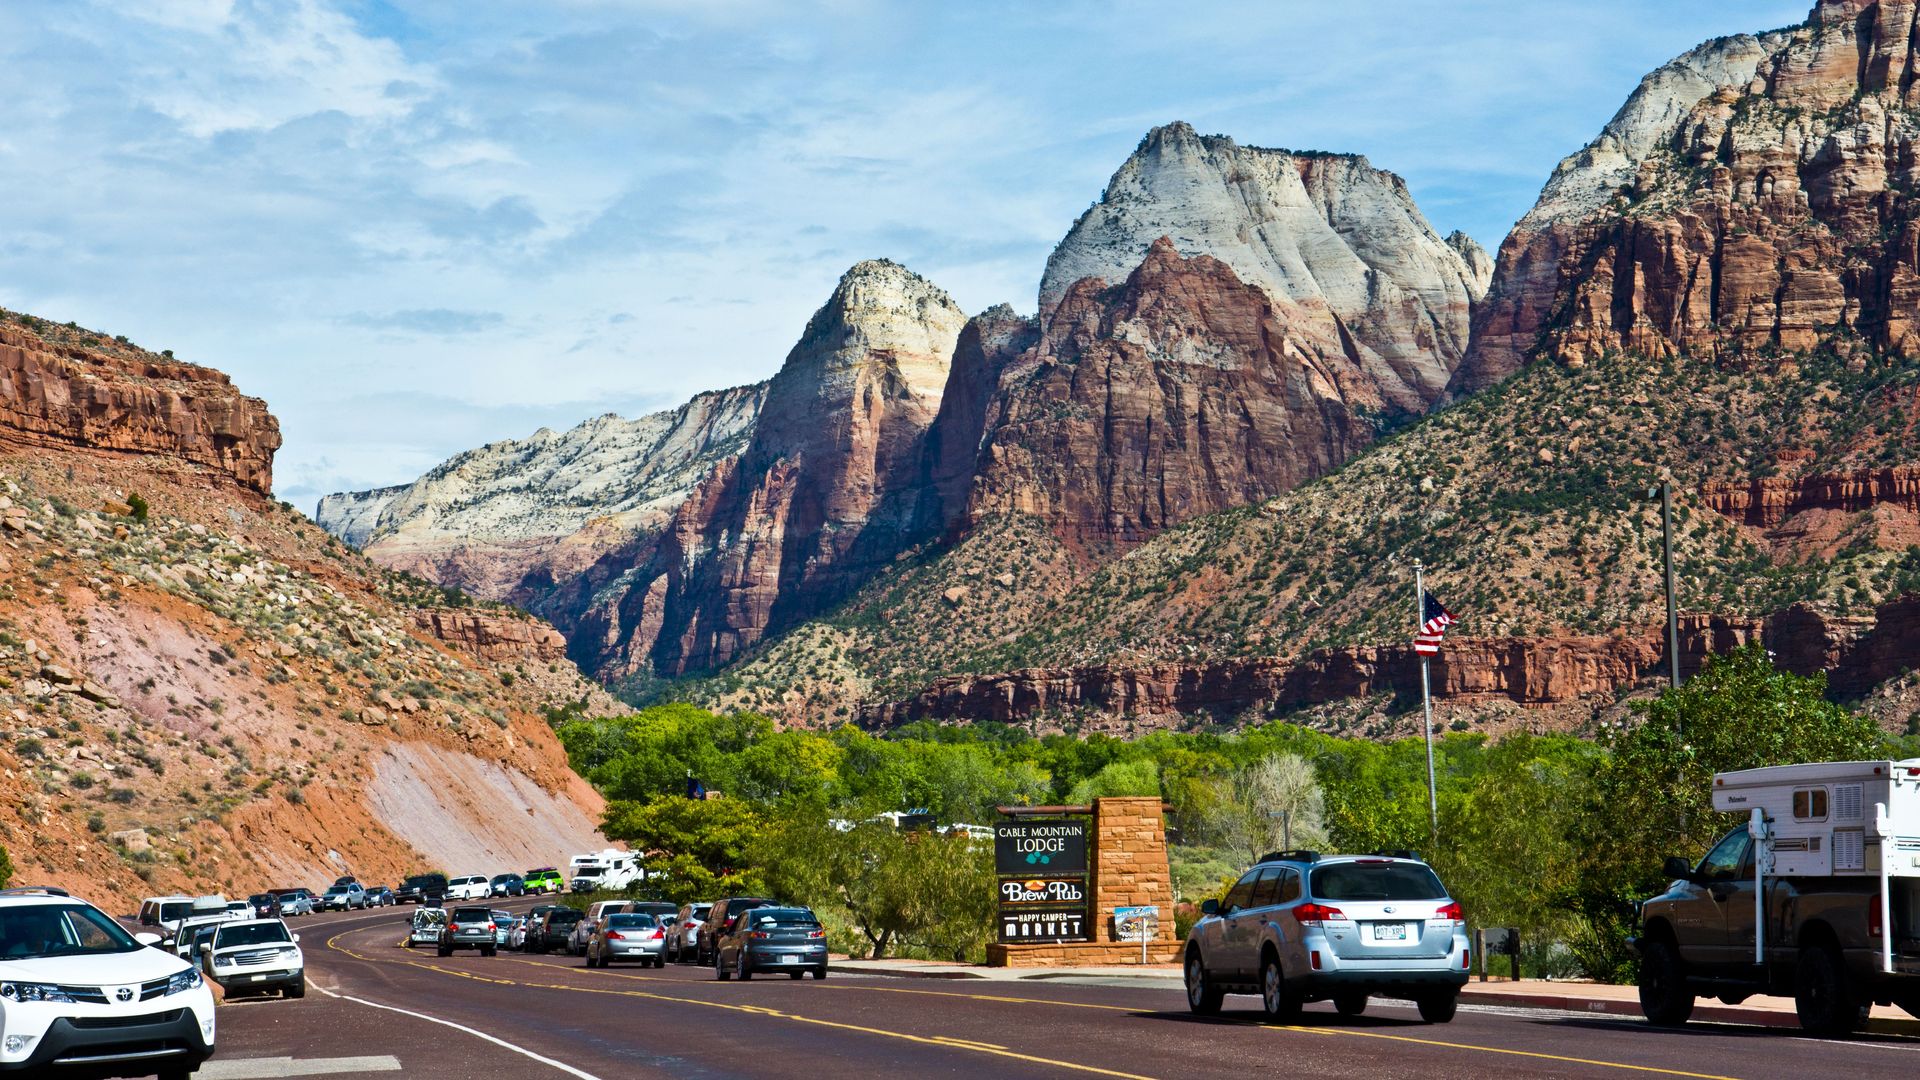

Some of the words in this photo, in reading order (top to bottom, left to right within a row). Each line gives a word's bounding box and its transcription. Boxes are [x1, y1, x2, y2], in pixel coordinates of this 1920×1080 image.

[999, 828, 1026, 837] CABLE
[1031, 827, 1082, 837] MOUNTAIN
[1017, 838, 1065, 852] LODGE
[1002, 882, 1048, 901] Brew
[1048, 882, 1082, 900] Pub
[1019, 914, 1040, 922] HAPPY
[1041, 913, 1067, 921] CAMPER
[1006, 922, 1080, 936] MARKET
